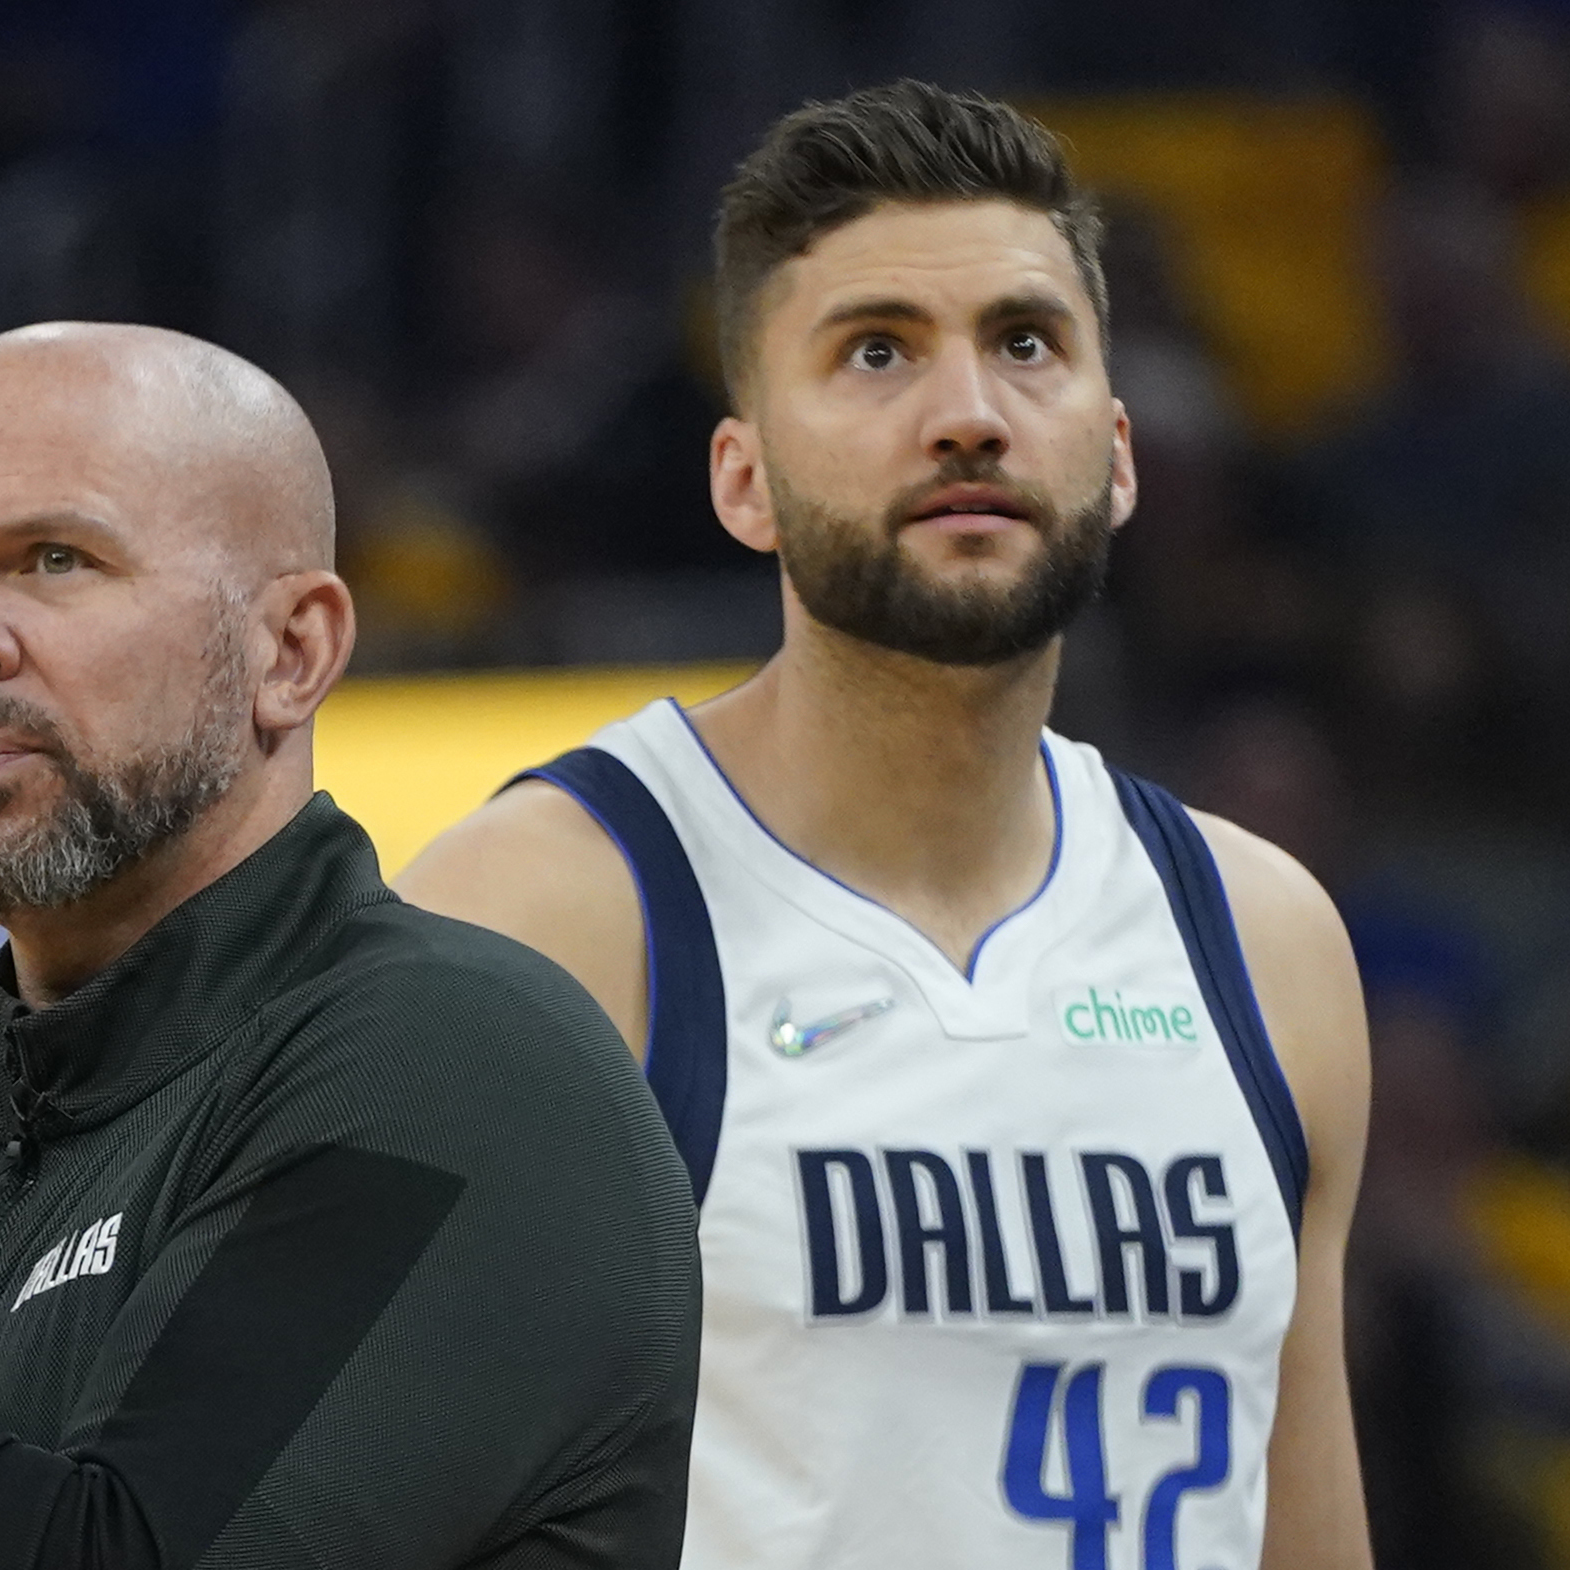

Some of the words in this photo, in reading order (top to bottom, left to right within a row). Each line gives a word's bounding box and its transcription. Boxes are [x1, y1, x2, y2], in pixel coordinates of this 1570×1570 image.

[1064, 988, 1199, 1044] chime
[10, 1211, 123, 1313] DALLAS
[792, 1146, 1242, 1326] DALLAS
